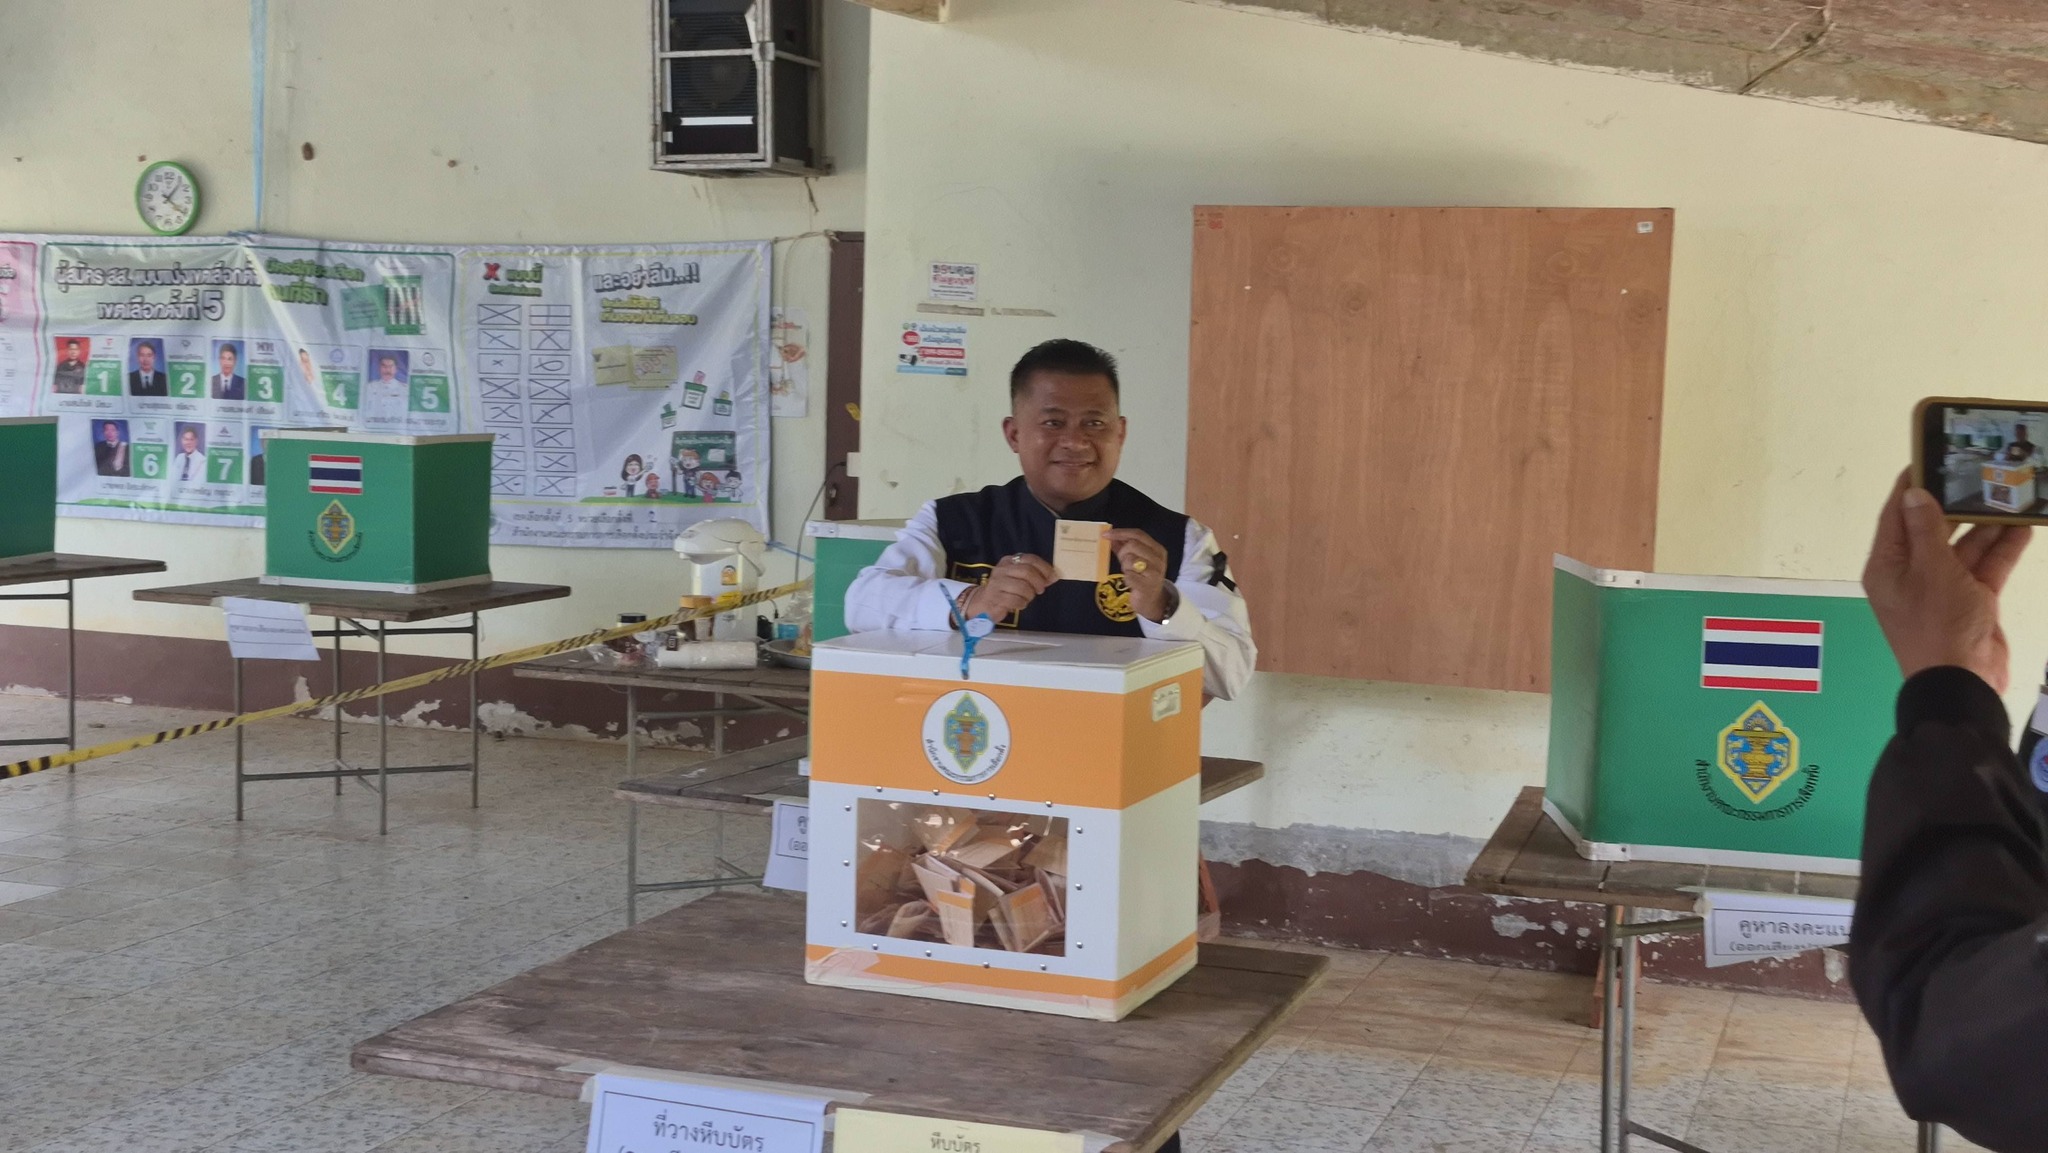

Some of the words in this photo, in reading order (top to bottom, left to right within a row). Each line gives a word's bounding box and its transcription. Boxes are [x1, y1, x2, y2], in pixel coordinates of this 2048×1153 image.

[56, 259, 106, 293] ผู้สมัคร
[134, 261, 262, 287] แบบแบ่งเขตเลือกตั้
[97, 289, 200, 321] เขตเลือกตั้งที่
[201, 290, 226, 321] 5
[96, 370, 110, 393] 1
[180, 372, 197, 396] 2
[257, 376, 274, 399] 3
[332, 382, 348, 406] 4
[420, 386, 440, 410] 5
[142, 453, 159, 477] 6
[217, 458, 233, 480] 7
[652, 1108, 766, 1153] ที่วางหีบบัตร
[930, 1131, 982, 1153] หีบบัตร
